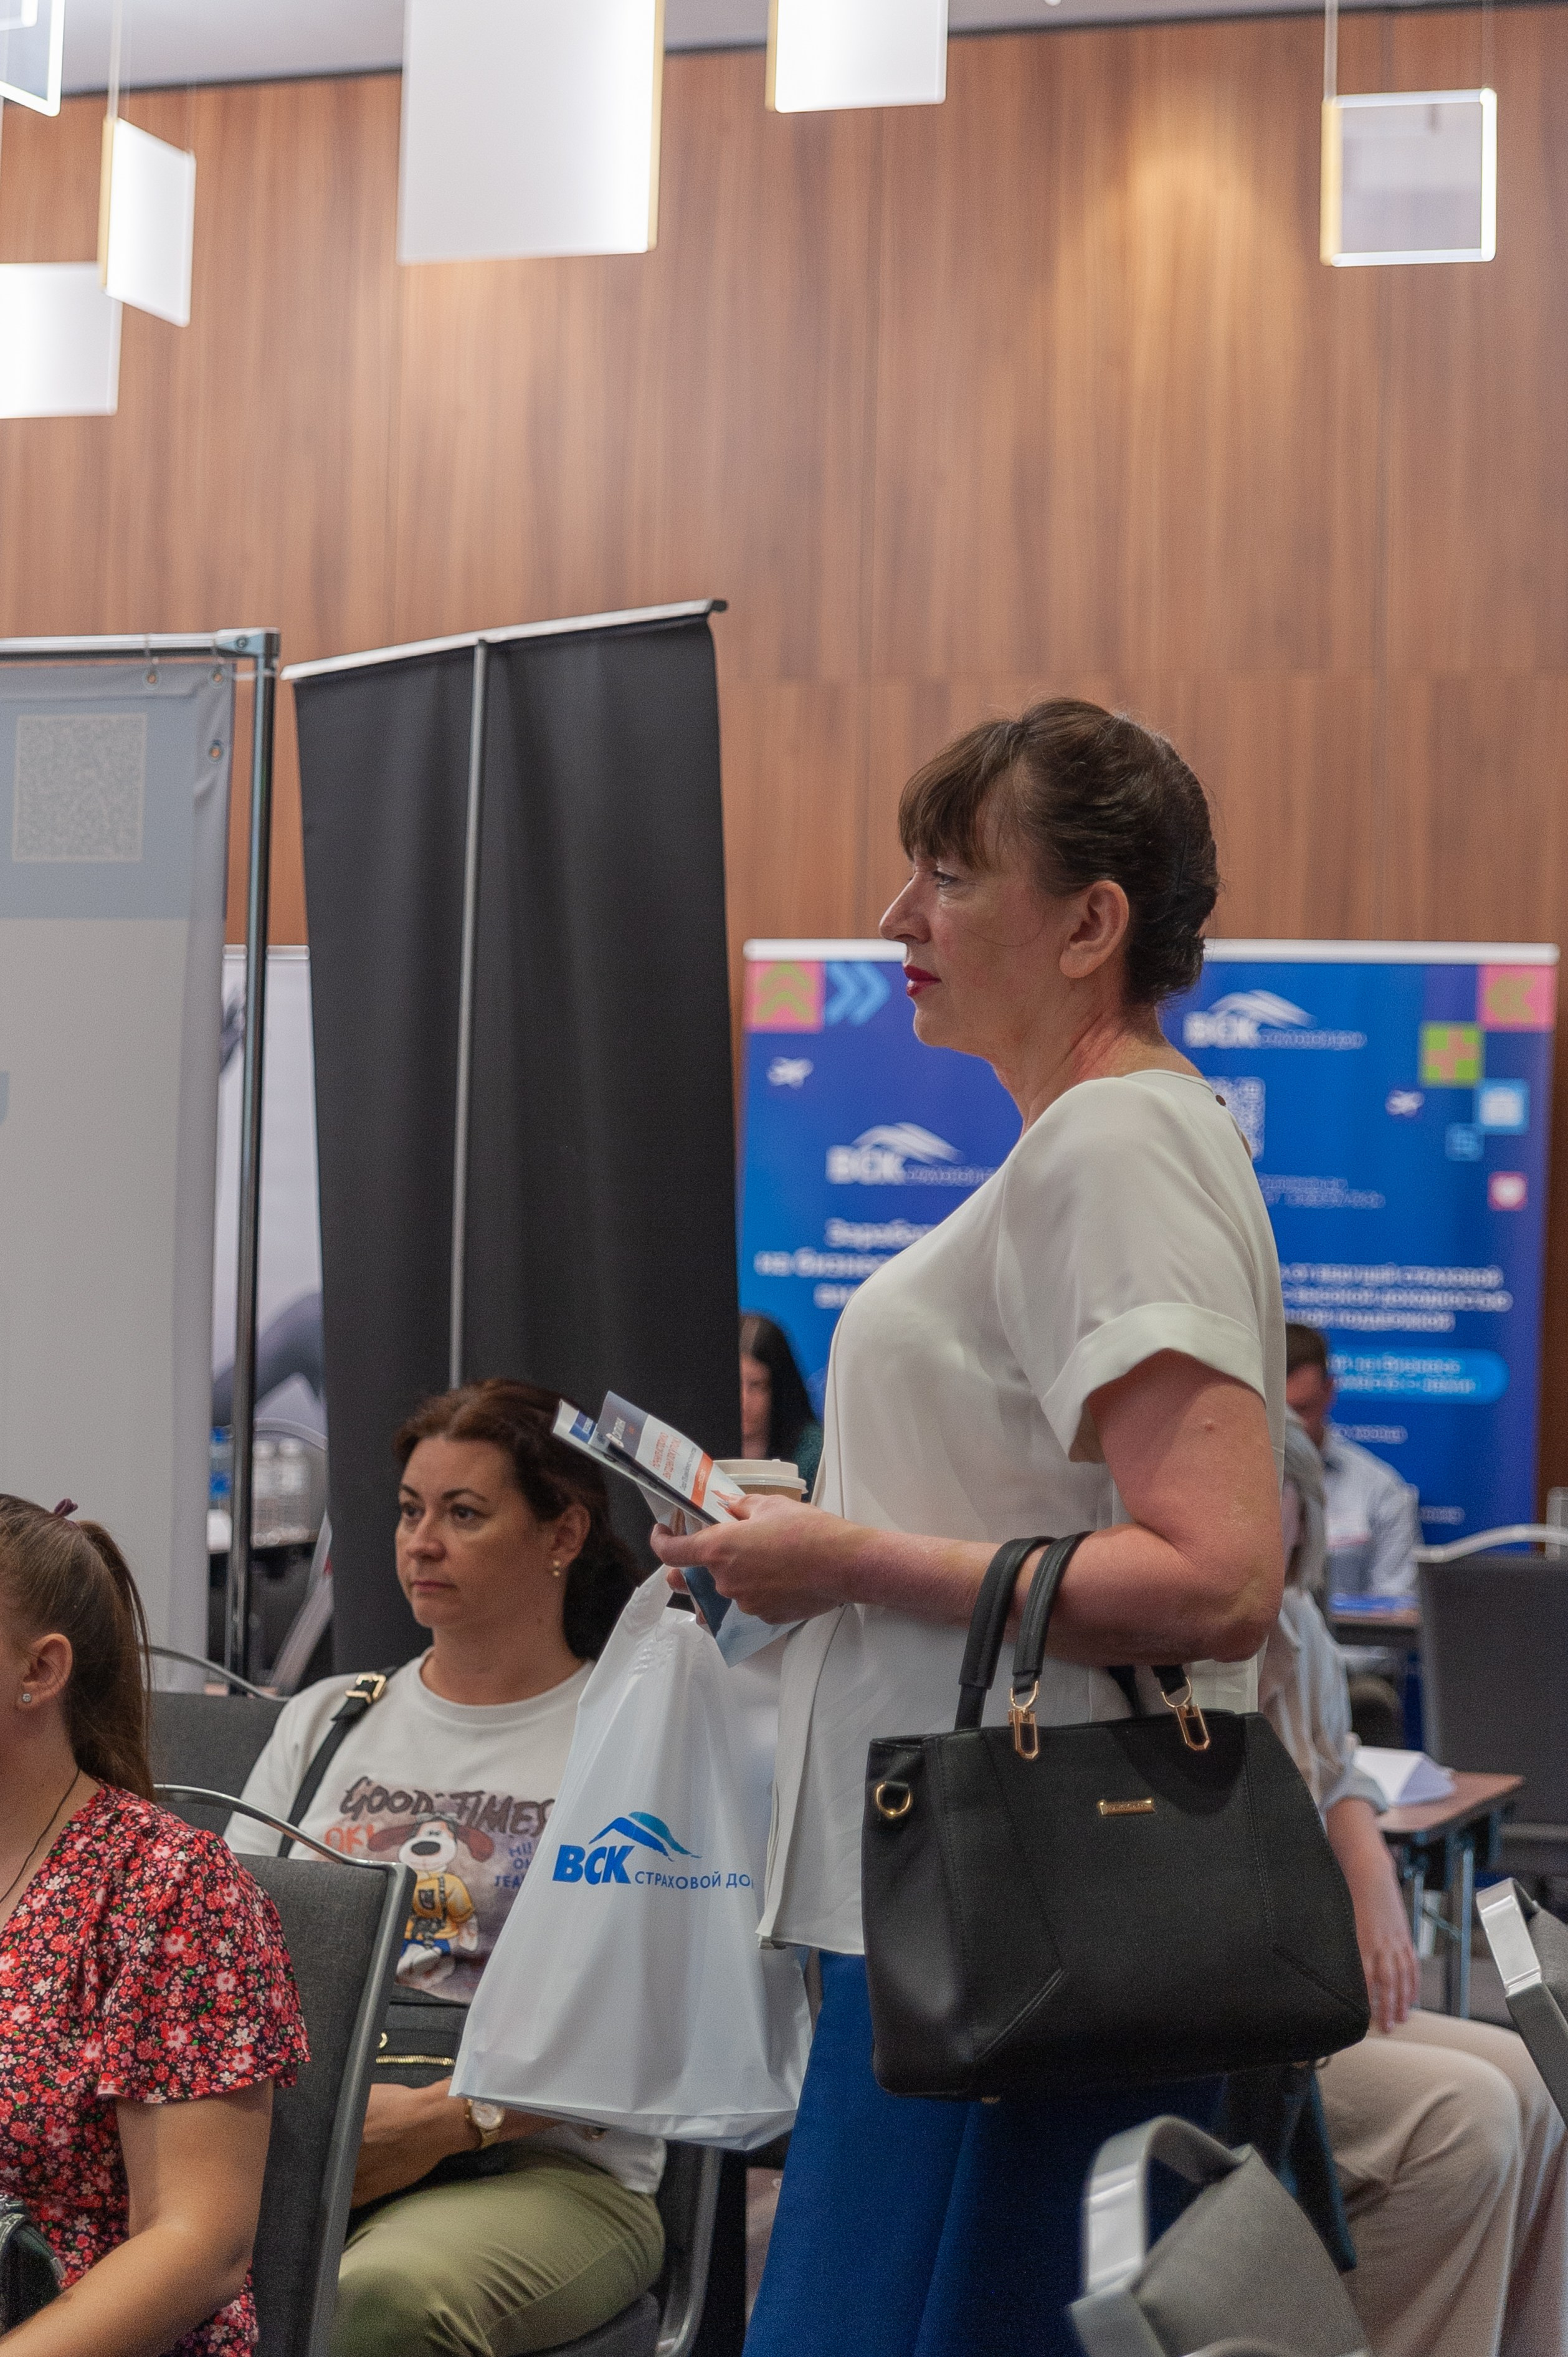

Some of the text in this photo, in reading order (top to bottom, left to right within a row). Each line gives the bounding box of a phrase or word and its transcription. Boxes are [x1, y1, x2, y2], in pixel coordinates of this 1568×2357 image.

[340, 1776, 555, 1837] GOOD TIMES
[553, 1845, 635, 1885] ВСК
[635, 1871, 753, 1889] СТРАХОВОЙ ДО
